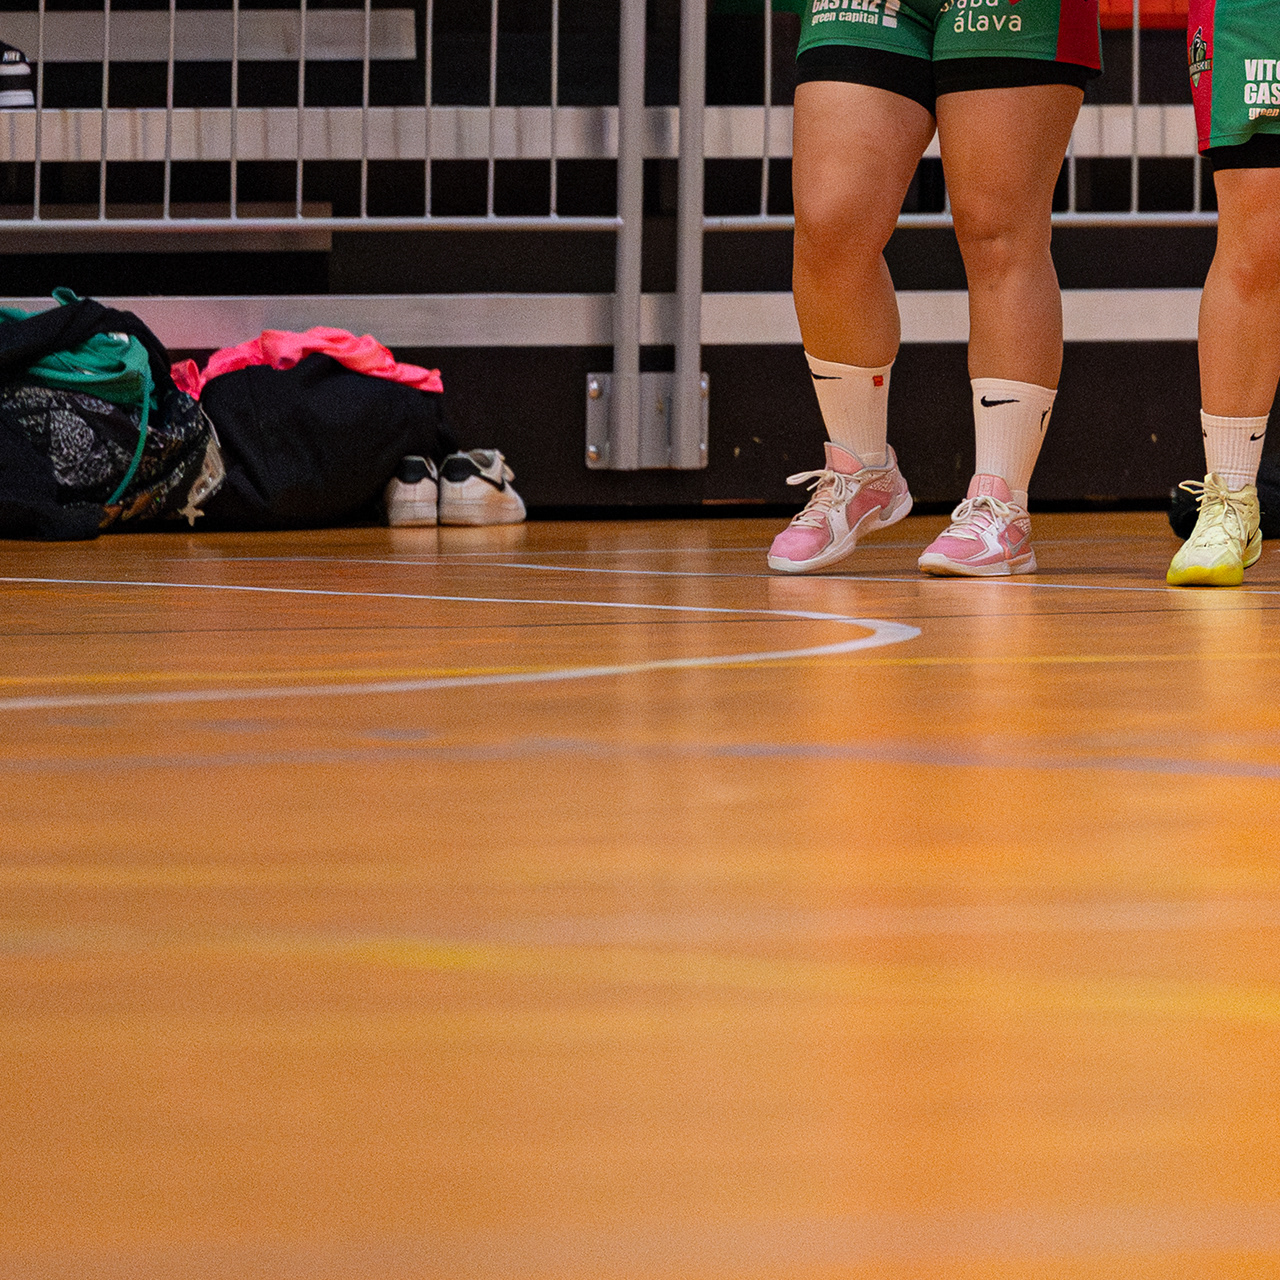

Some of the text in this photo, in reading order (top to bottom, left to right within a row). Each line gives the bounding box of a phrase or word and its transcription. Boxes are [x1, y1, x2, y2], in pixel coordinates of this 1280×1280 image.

[811, 11, 879, 27] green capital
[953, 10, 1022, 33] álava
